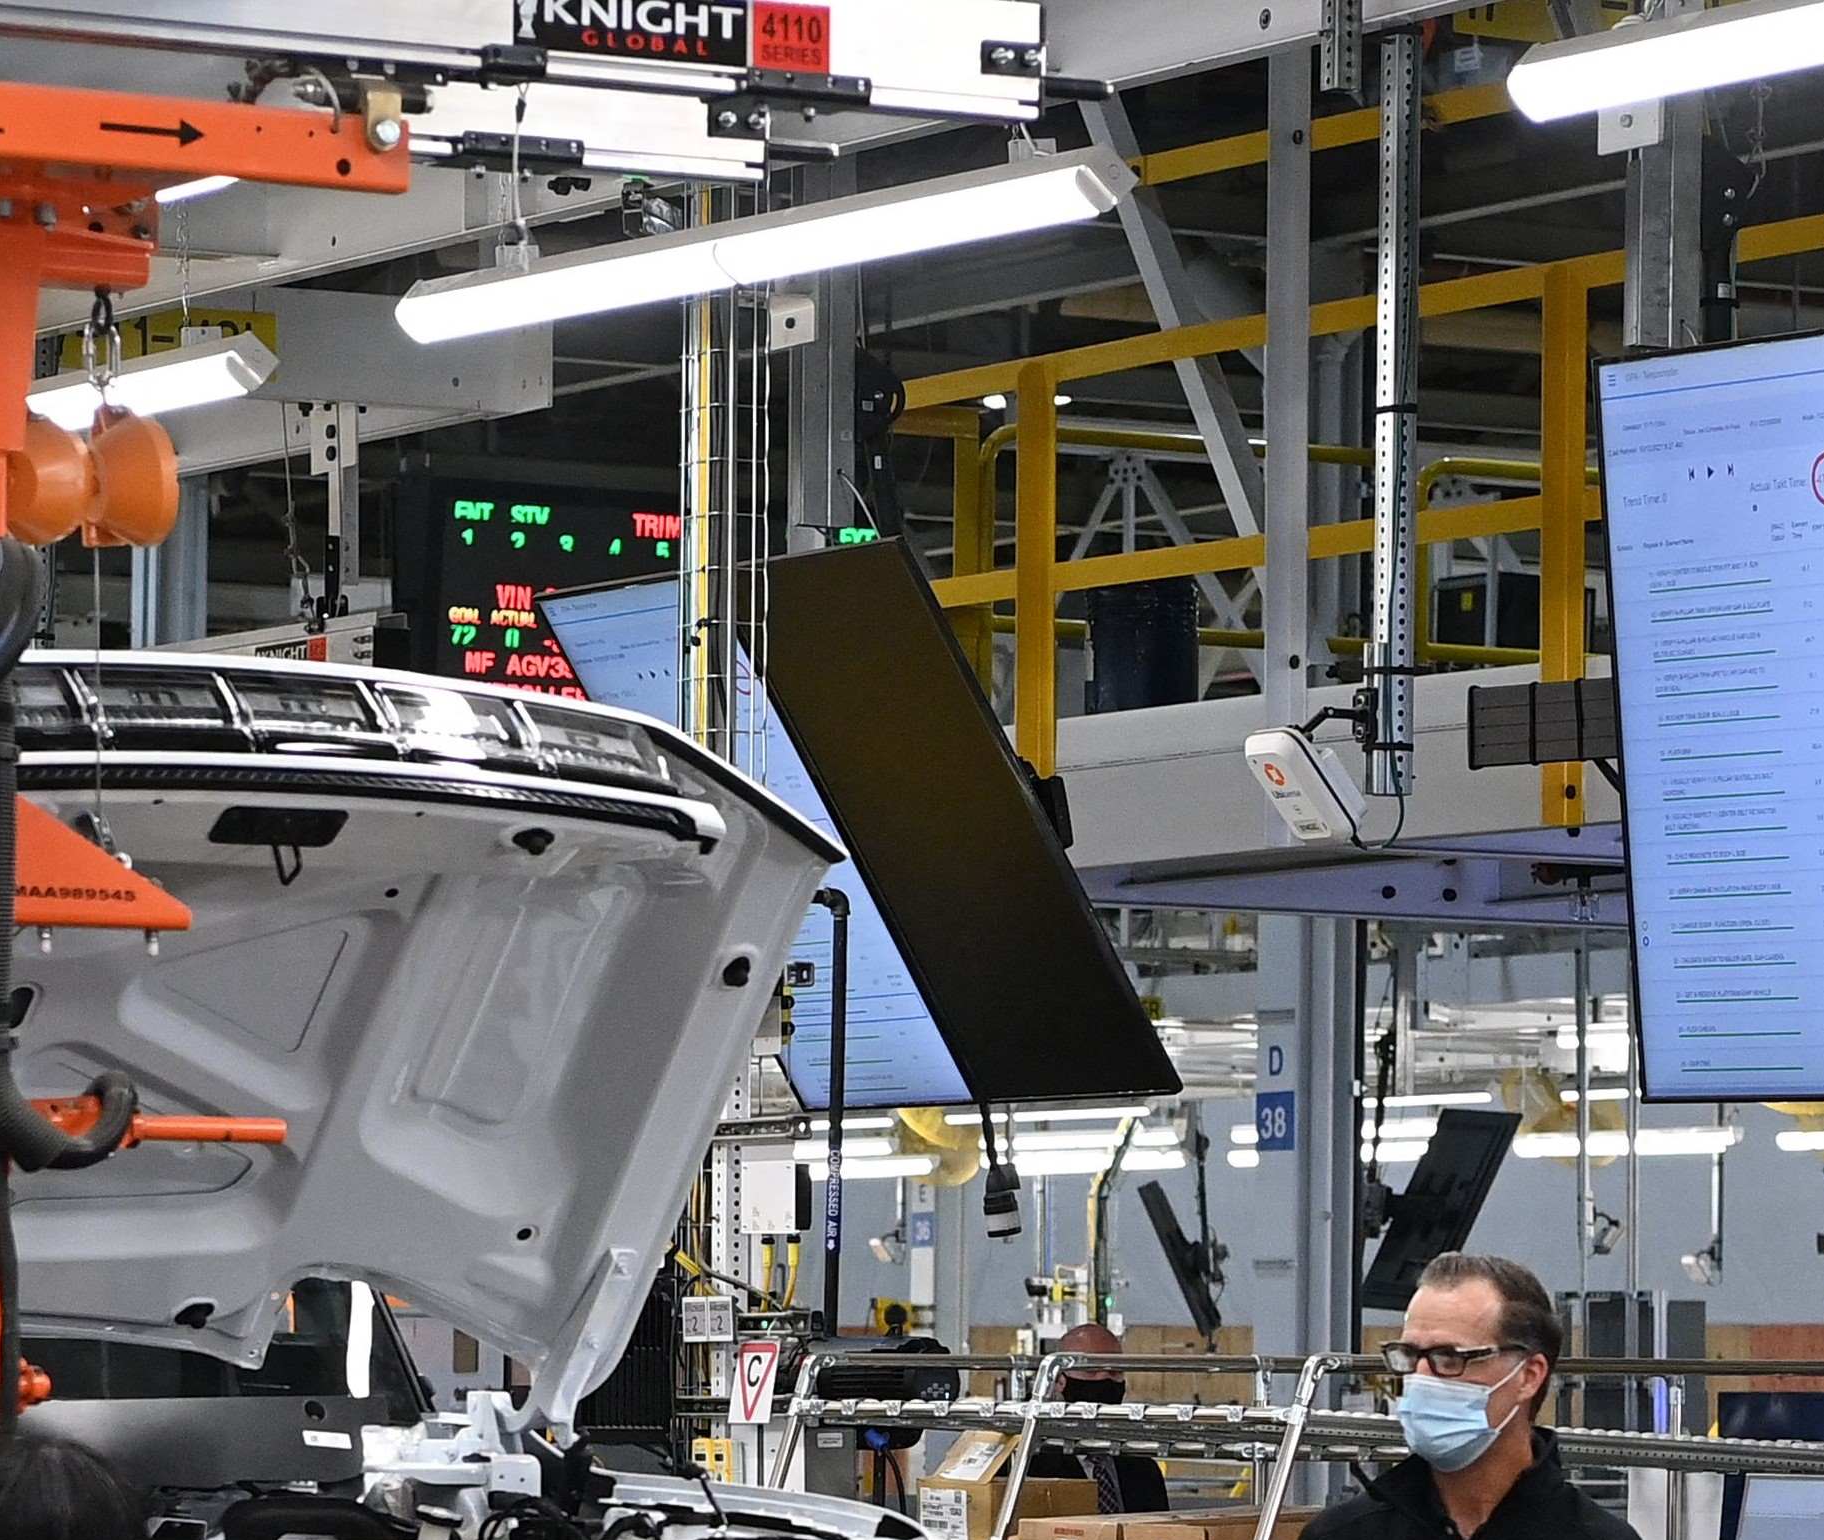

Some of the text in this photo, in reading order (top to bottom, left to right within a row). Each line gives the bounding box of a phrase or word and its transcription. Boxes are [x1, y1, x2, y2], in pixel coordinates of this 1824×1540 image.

[543, 0, 745, 40] KNIGHT
[760, 11, 822, 45] 4110
[580, 28, 709, 57] GLOBAL
[760, 43, 822, 66] SERIES
[632, 512, 682, 539] TRIM
[495, 584, 532, 610] VIN
[490, 610, 538, 628] ACTUAL
[464, 651, 496, 674] MF
[1269, 1045, 1284, 1076] D
[1261, 1106, 1287, 1139] 38
[826, 1149, 840, 1238] COMPRESSED AIR
[747, 1354, 763, 1387] C
